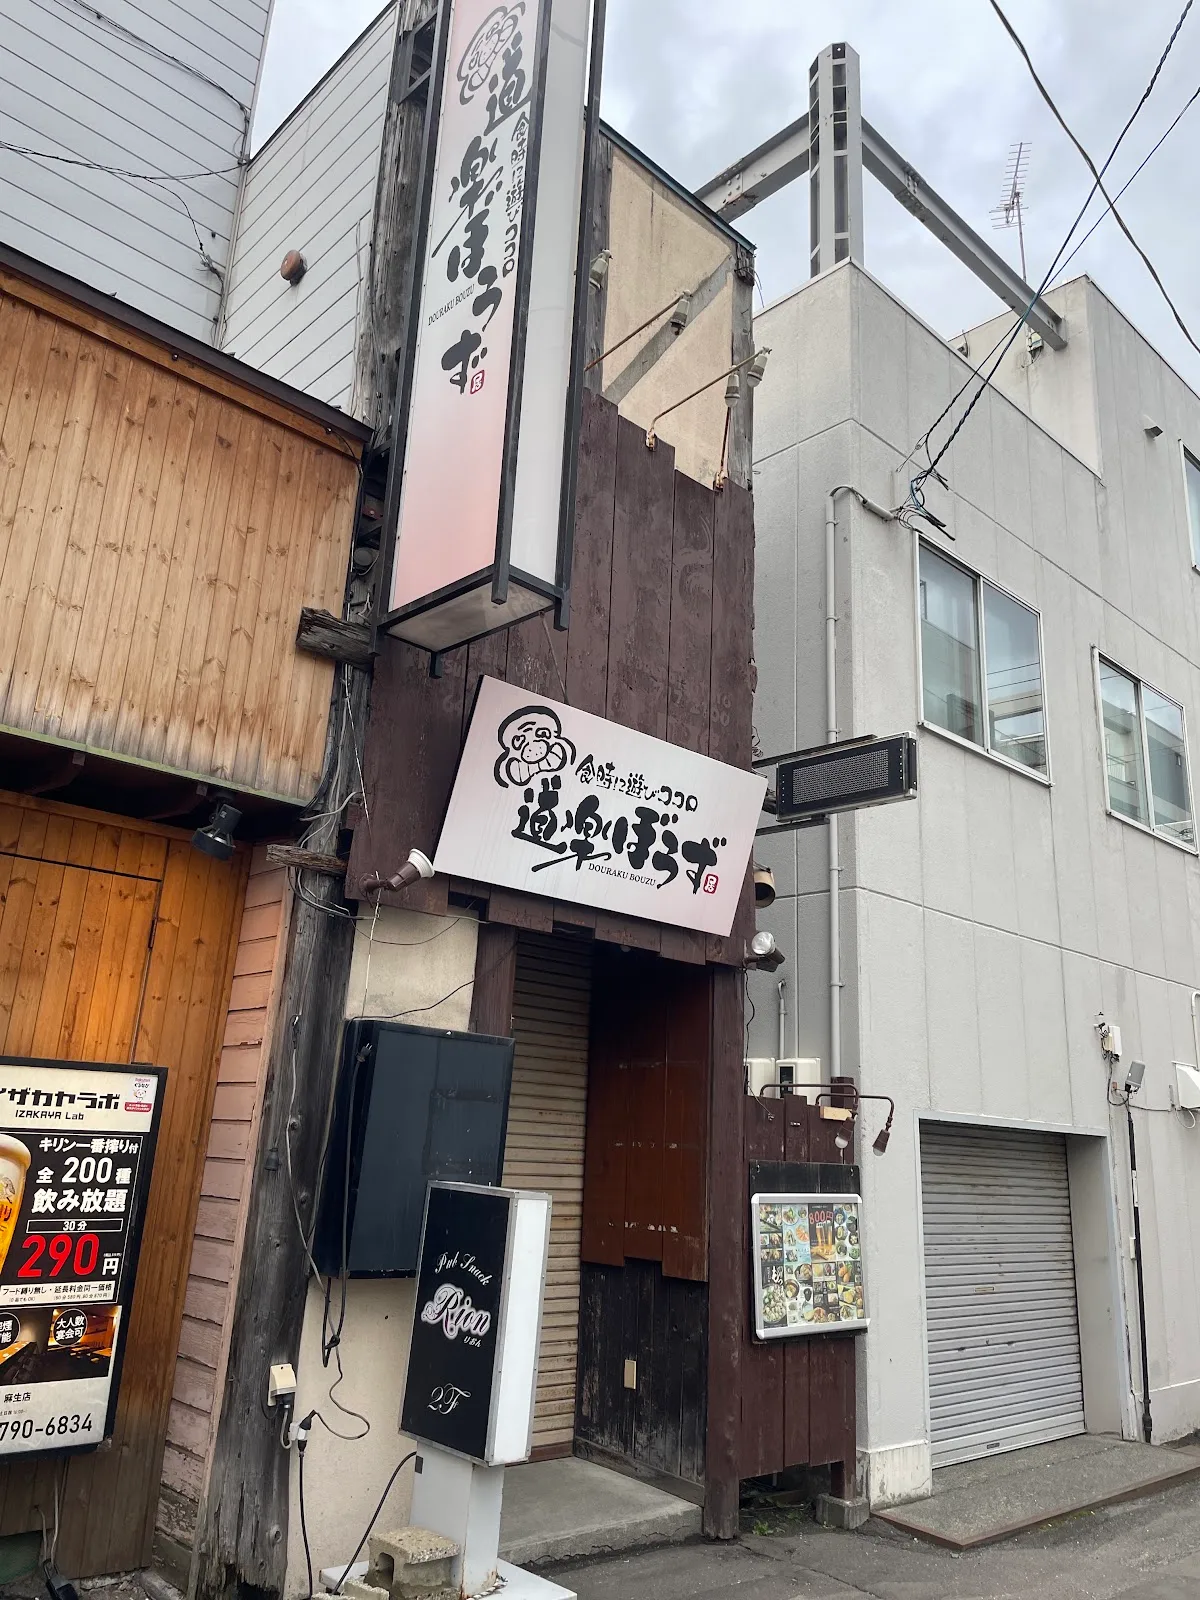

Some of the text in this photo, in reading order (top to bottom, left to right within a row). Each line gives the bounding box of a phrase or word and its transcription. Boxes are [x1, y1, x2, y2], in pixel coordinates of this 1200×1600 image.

[428, 284, 475, 326] DOURAKU BOUZU
[588, 863, 656, 886] DOURAKU BOUZU
[15, 1110, 84, 1120] IZAKAYA Lab
[31, 1188, 128, 1213] 飲み放題
[434, 1251, 493, 1286] Pub Snack
[56, 1315, 85, 1330] 大人数
[422, 1284, 490, 1338] Rion
[0, 1332, 12, 1344] 能
[55, 1327, 84, 1341] 宴会可
[427, 1382, 471, 1415] 2F
